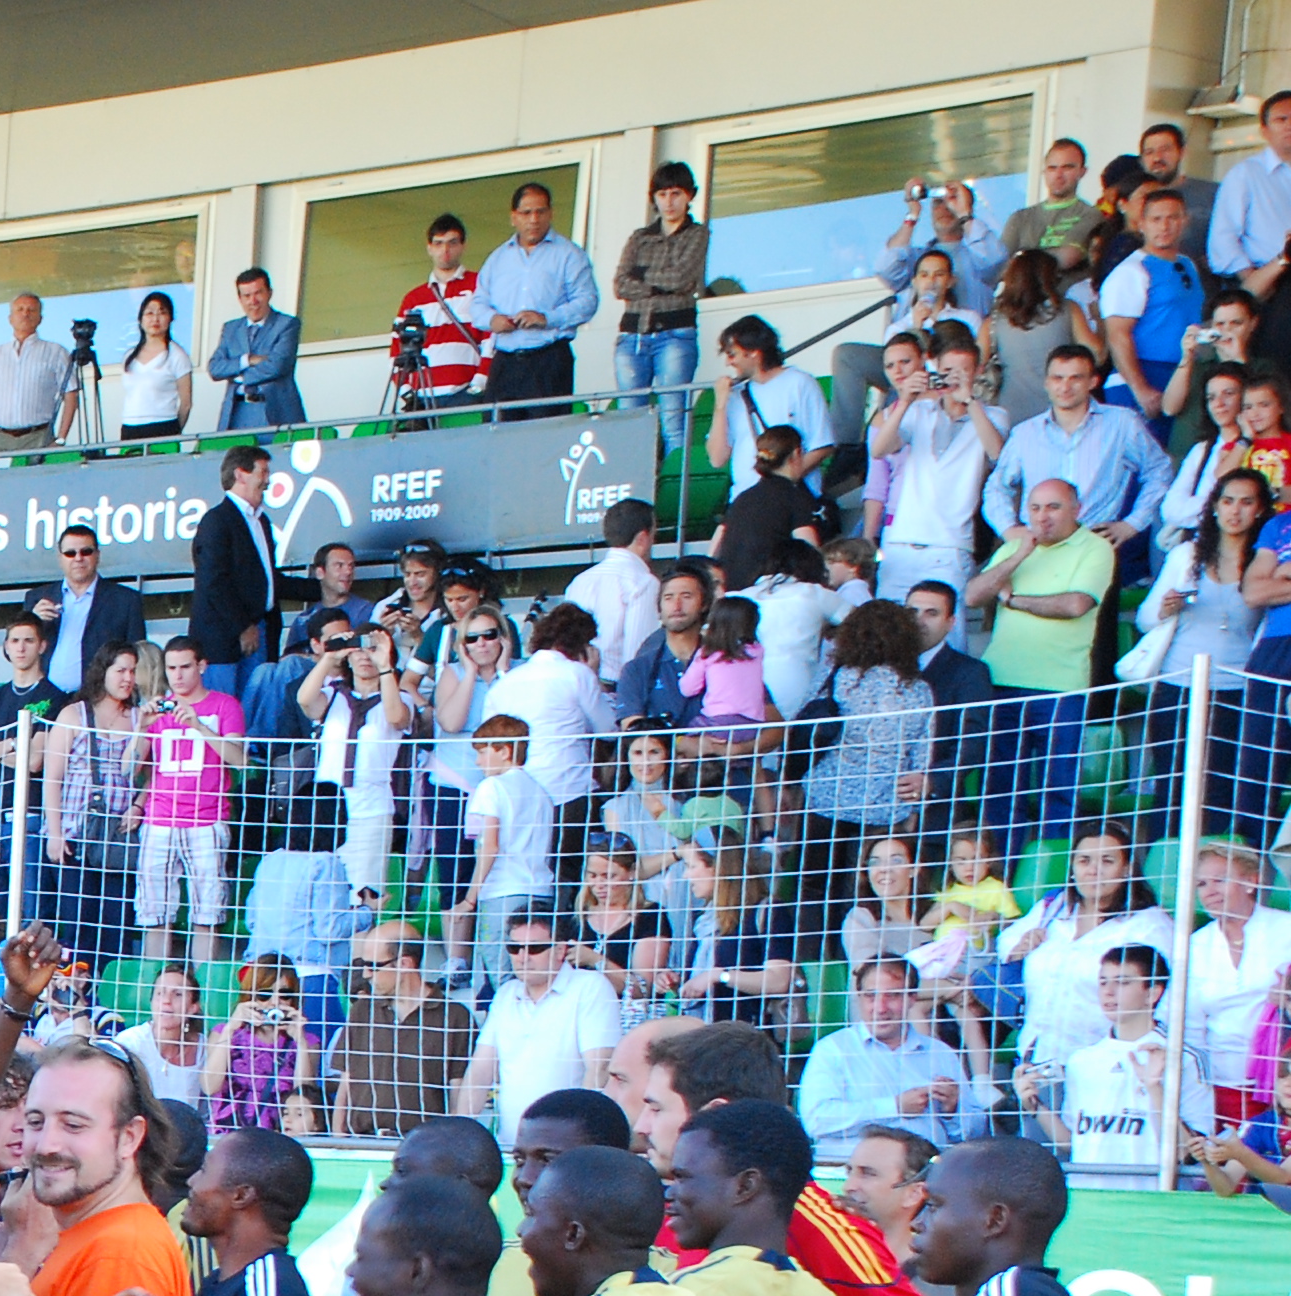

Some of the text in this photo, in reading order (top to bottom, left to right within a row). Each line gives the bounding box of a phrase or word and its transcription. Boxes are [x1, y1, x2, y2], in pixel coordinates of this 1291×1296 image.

[372, 469, 443, 503] RFEF
[577, 484, 632, 511] RFEF
[1076, 1108, 1146, 1136] bwin
